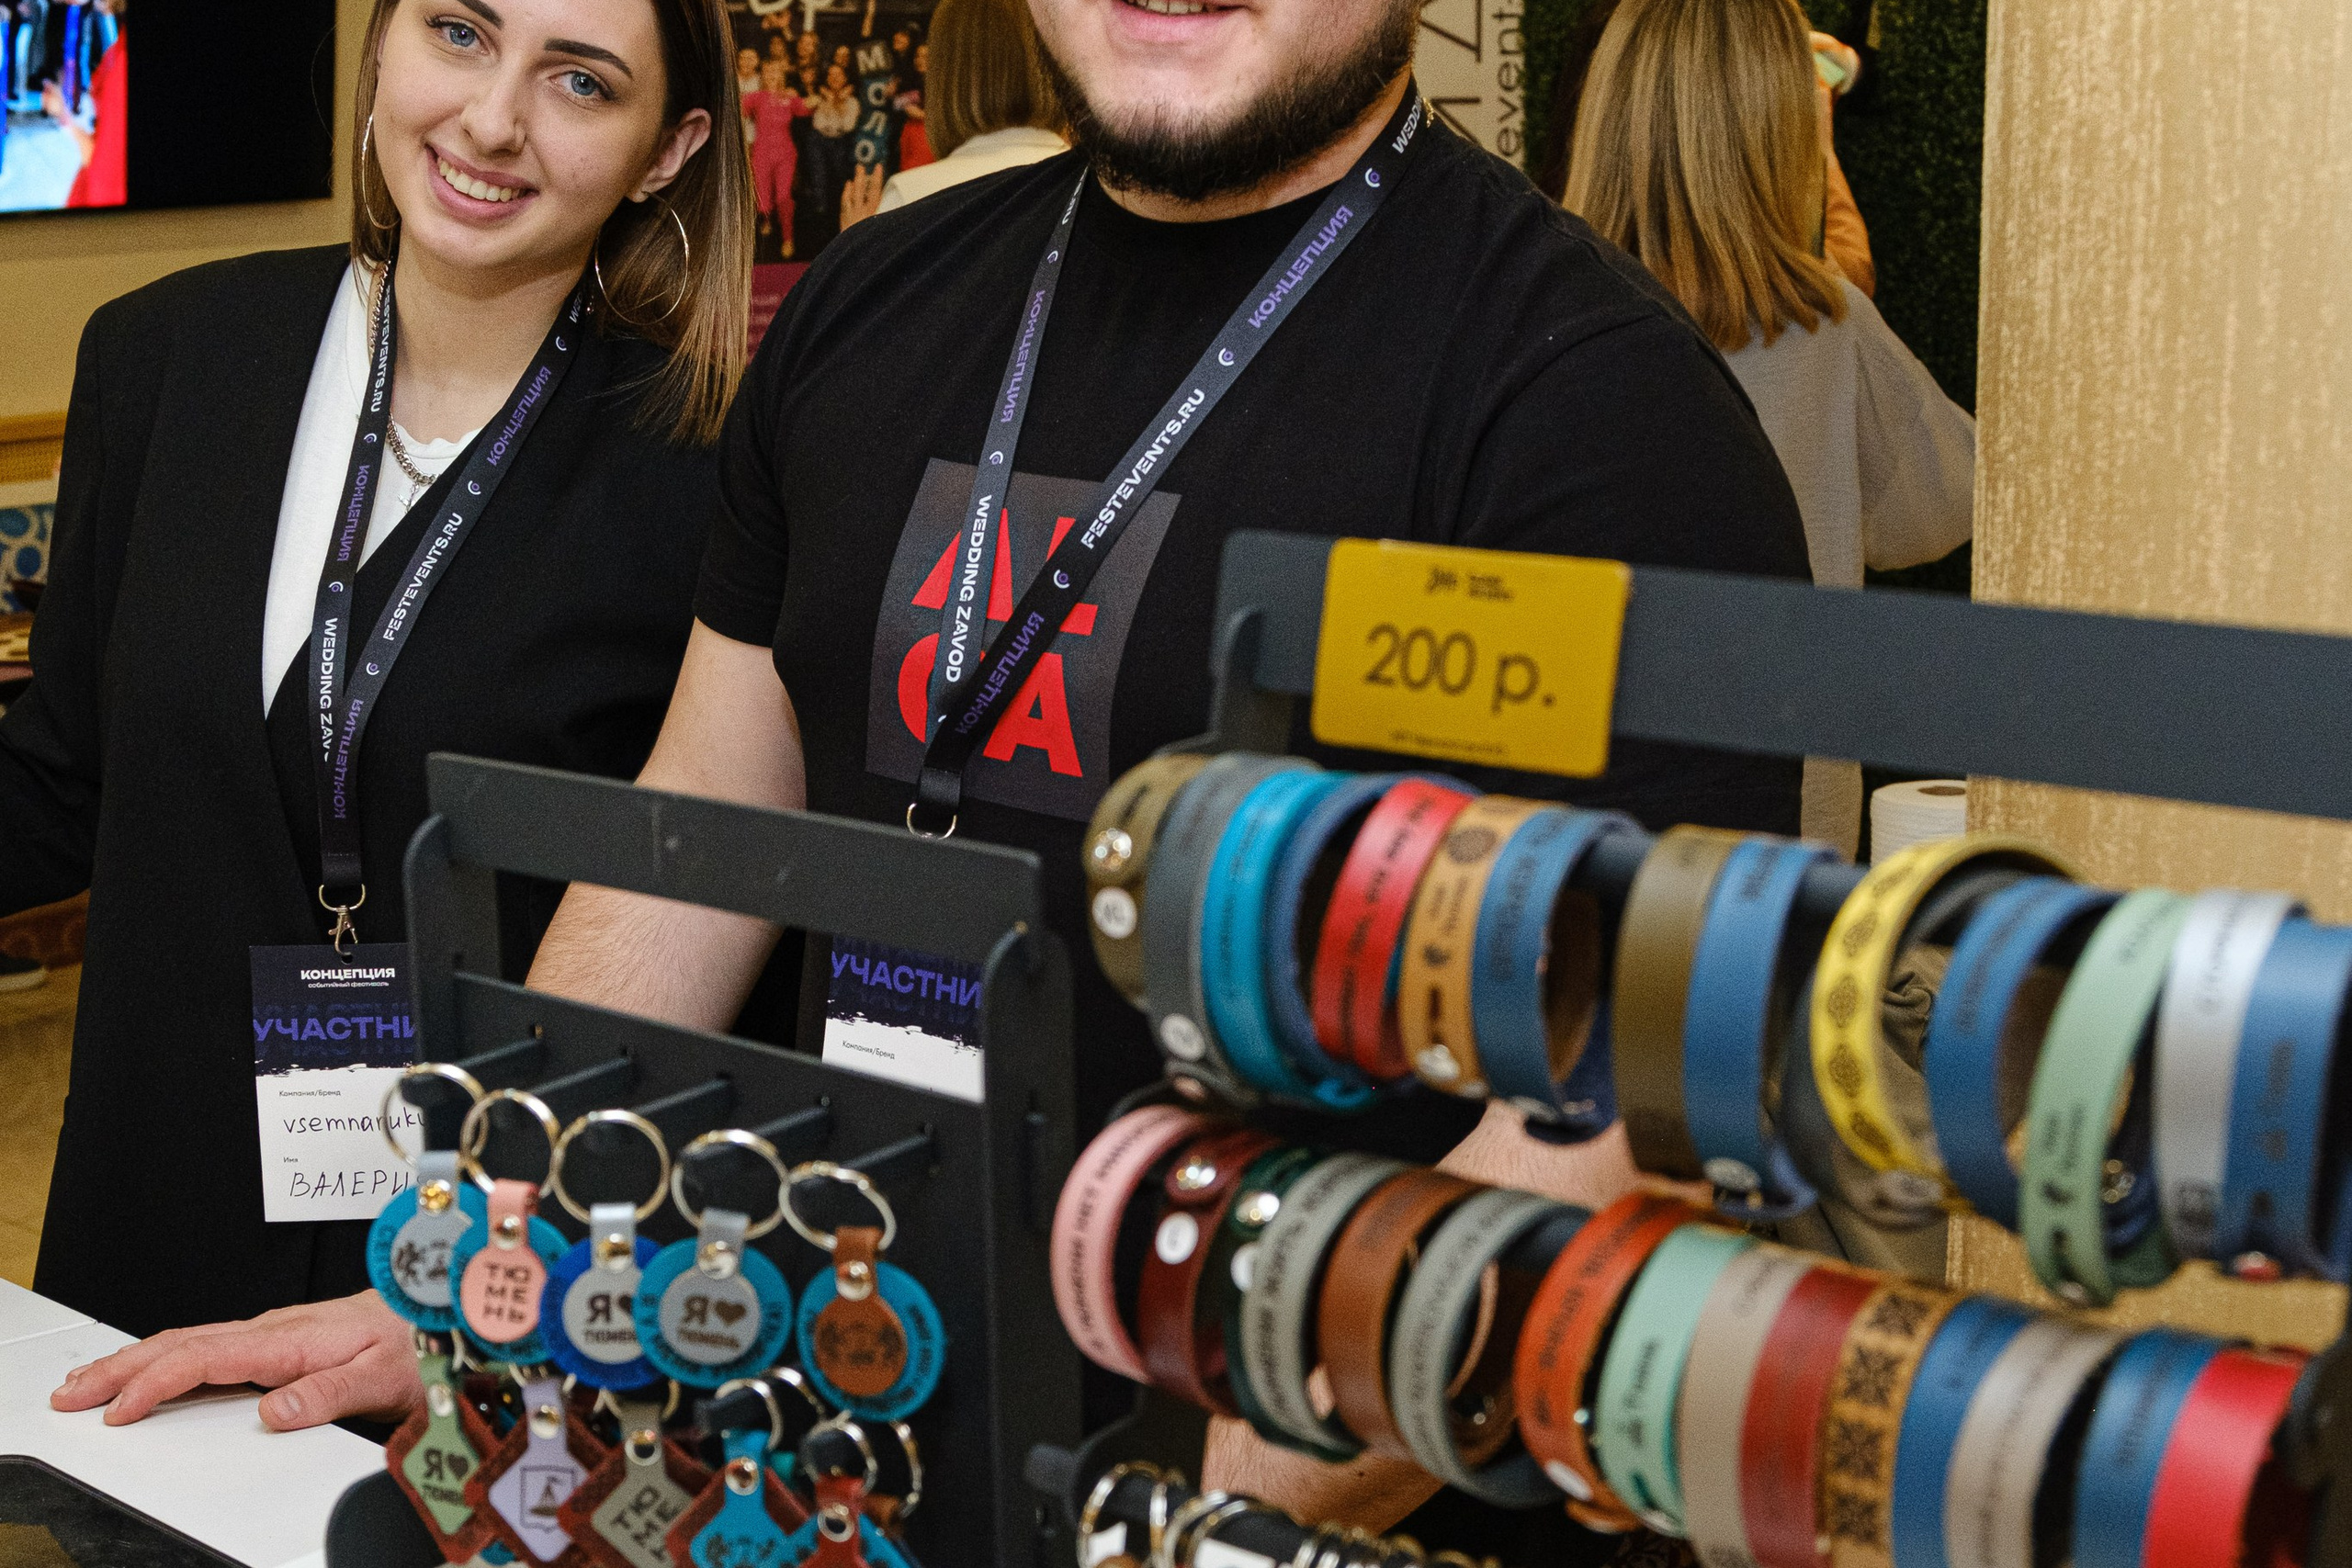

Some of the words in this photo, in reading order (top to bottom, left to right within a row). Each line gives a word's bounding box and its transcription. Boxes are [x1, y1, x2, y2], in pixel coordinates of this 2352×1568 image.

[1492, 0, 1521, 156] event
[1248, 206, 1353, 329] КОНЦЕПЦИЯ
[1001, 290, 1046, 423] КОНЦЕПЦИЯ
[487, 366, 551, 466] КОНЦЕПЦИЯ
[337, 465, 369, 562] КОНЦЕПЦИЯ
[1080, 389, 1204, 549] FESTEVENTS.RU
[383, 512, 463, 641] FESTEVENTS.RU
[958, 494, 992, 603] WEDDING
[320, 618, 338, 709] WEDDING
[945, 605, 972, 682] ZAVOD
[955, 611, 1045, 734] КОНЦЕПЦИЯ
[1363, 622, 1477, 696] 200
[320, 713, 334, 763] ZAV
[300, 967, 395, 980] КОНЦЕПЦИЯ
[831, 951, 982, 1009] УЧАСТНИ
[253, 1015, 416, 1042] УЧАСТНИ
[289, 1169, 409, 1199] ВАЛЕРИ
